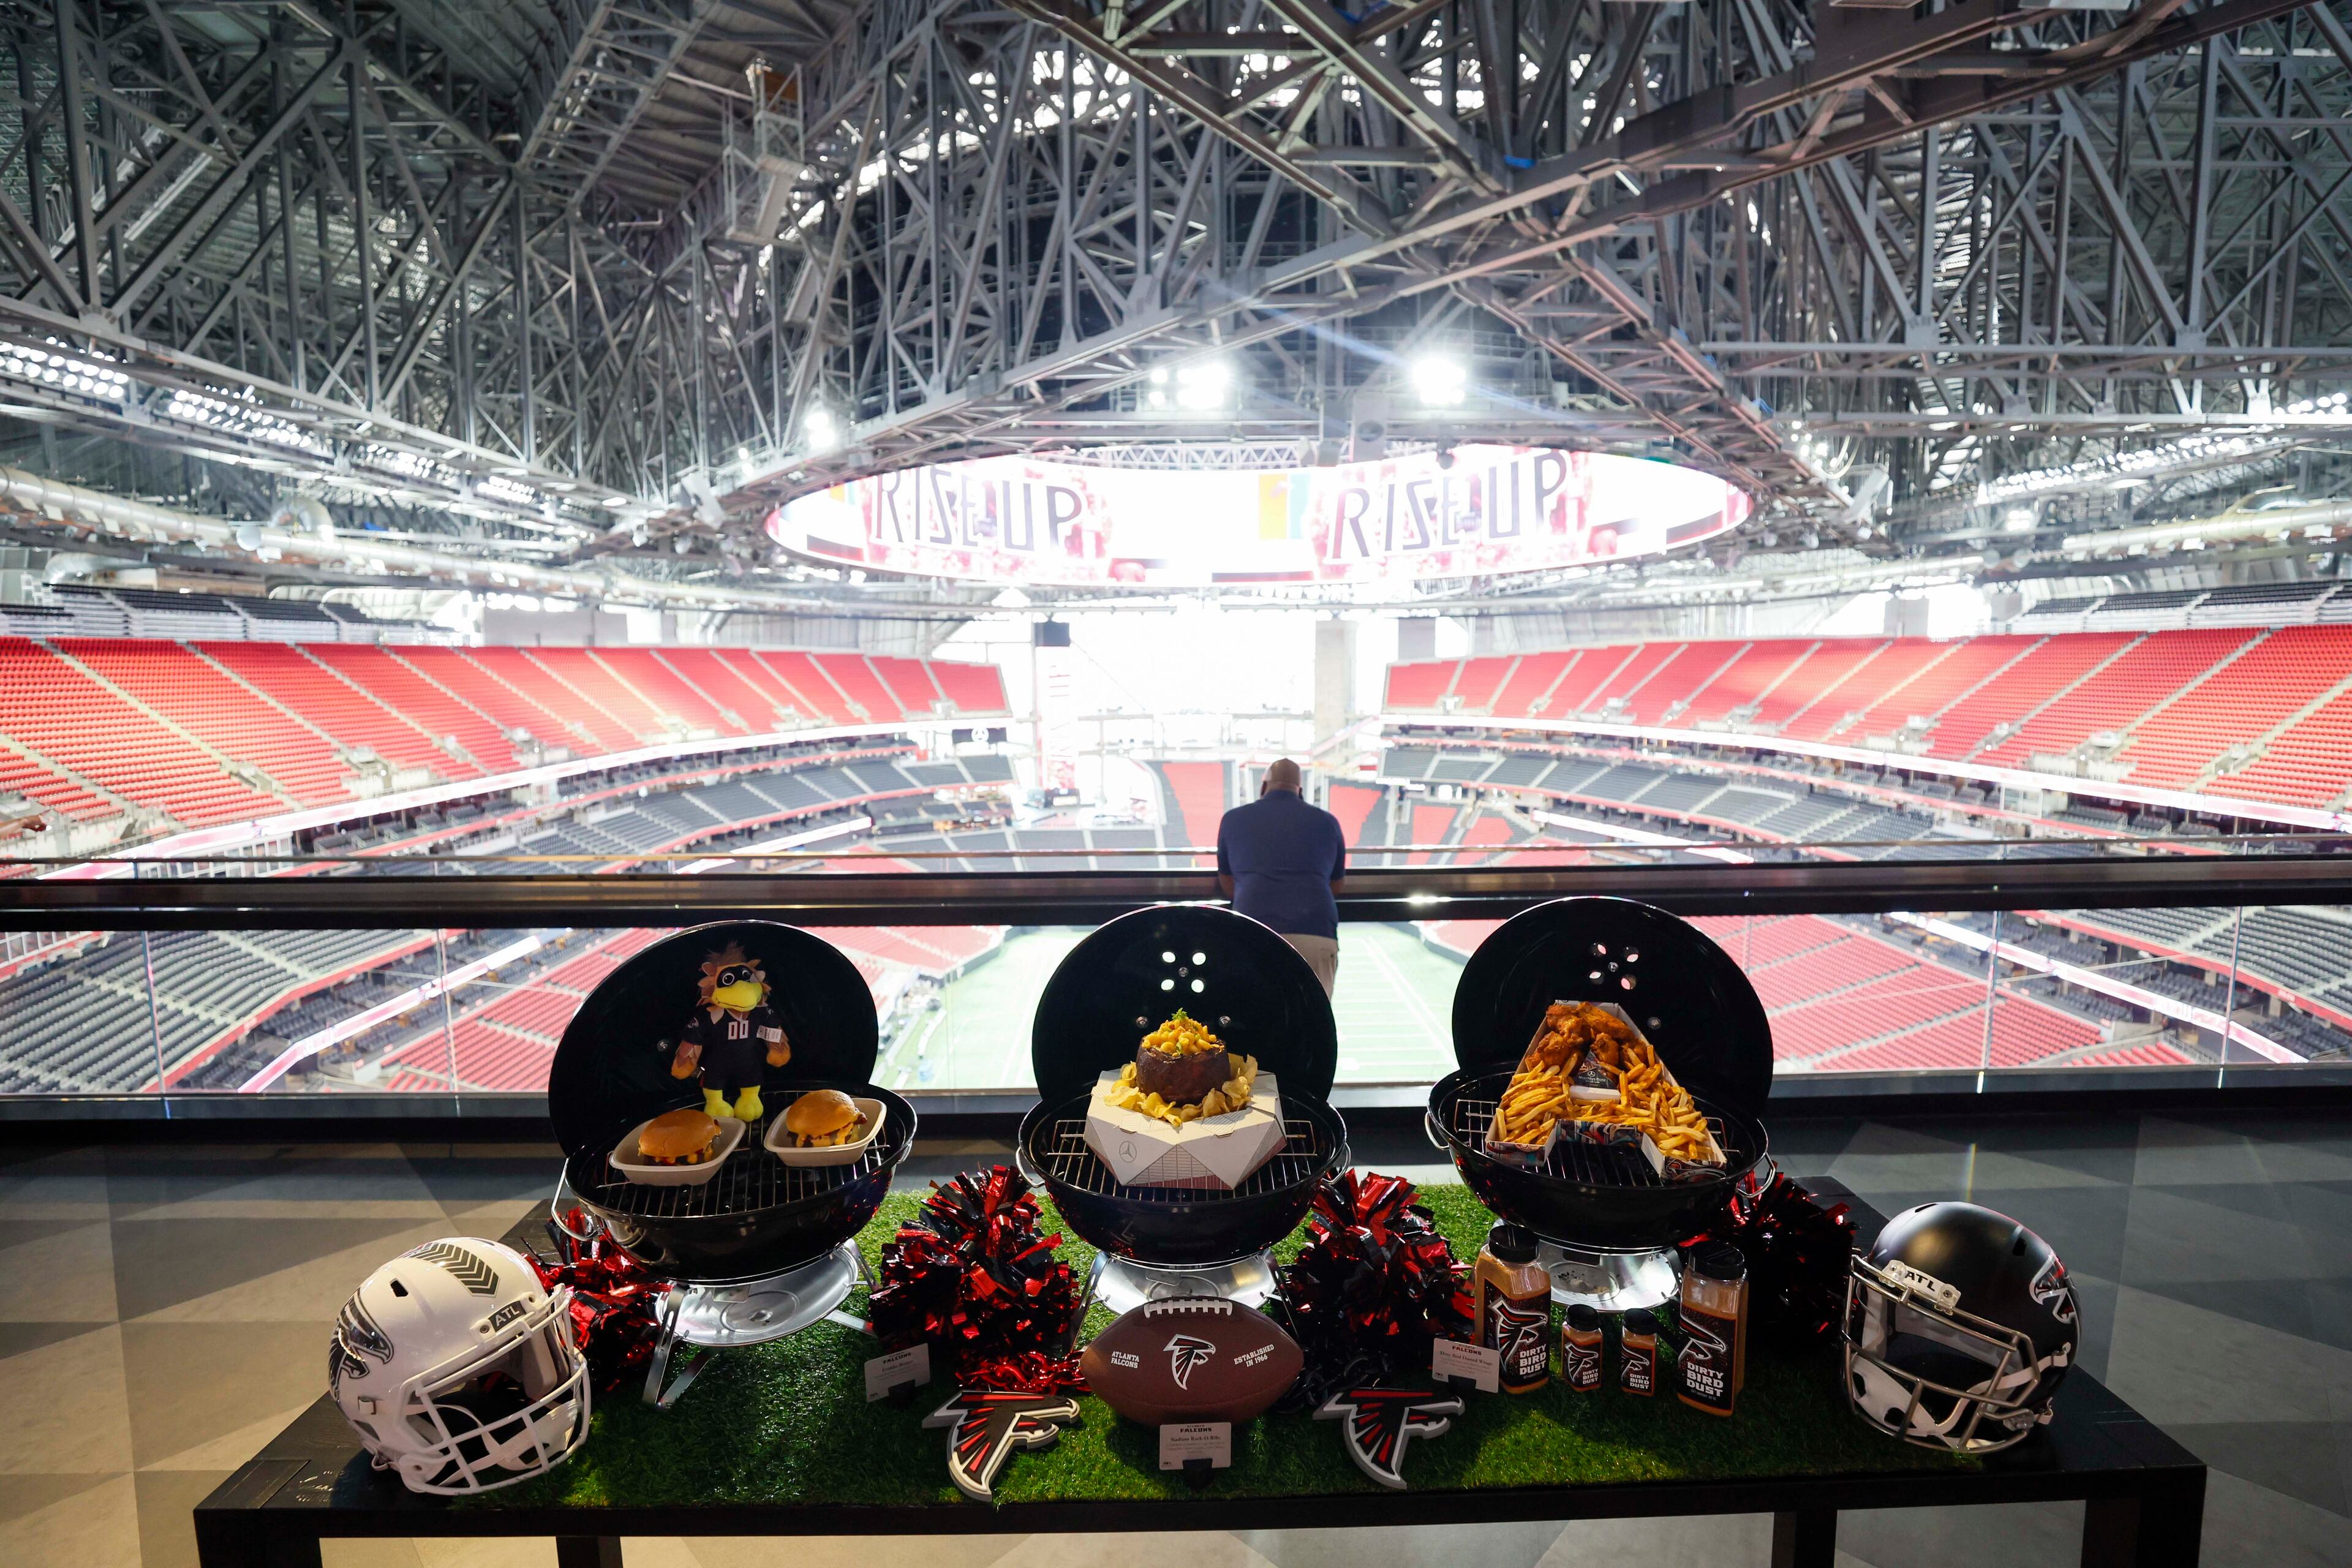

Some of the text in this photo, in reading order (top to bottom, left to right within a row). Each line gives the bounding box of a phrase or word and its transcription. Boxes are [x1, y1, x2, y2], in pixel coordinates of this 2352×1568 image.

[875, 467, 1083, 551] RISE UP
[1332, 450, 1567, 560] RISE UP
[728, 1020, 749, 1040] 00
[1904, 1270, 1935, 1292] ATL
[495, 1305, 520, 1327] ATL
[1111, 1351, 1140, 1362] ATLANTA
[1234, 1344, 1275, 1365] ESTABLISHED
[1452, 1346, 1482, 1355] FALCONS
[1519, 1343, 1547, 1358] DIRTY
[1519, 1351, 1547, 1367] BIRD
[1110, 1357, 1138, 1369] FALCONS
[1245, 1354, 1268, 1368] IN 1966
[1519, 1360, 1547, 1375] DUST
[1686, 1361, 1724, 1379] DIRTY
[1686, 1369, 1724, 1389] BIRD
[1686, 1378, 1723, 1396] DUST
